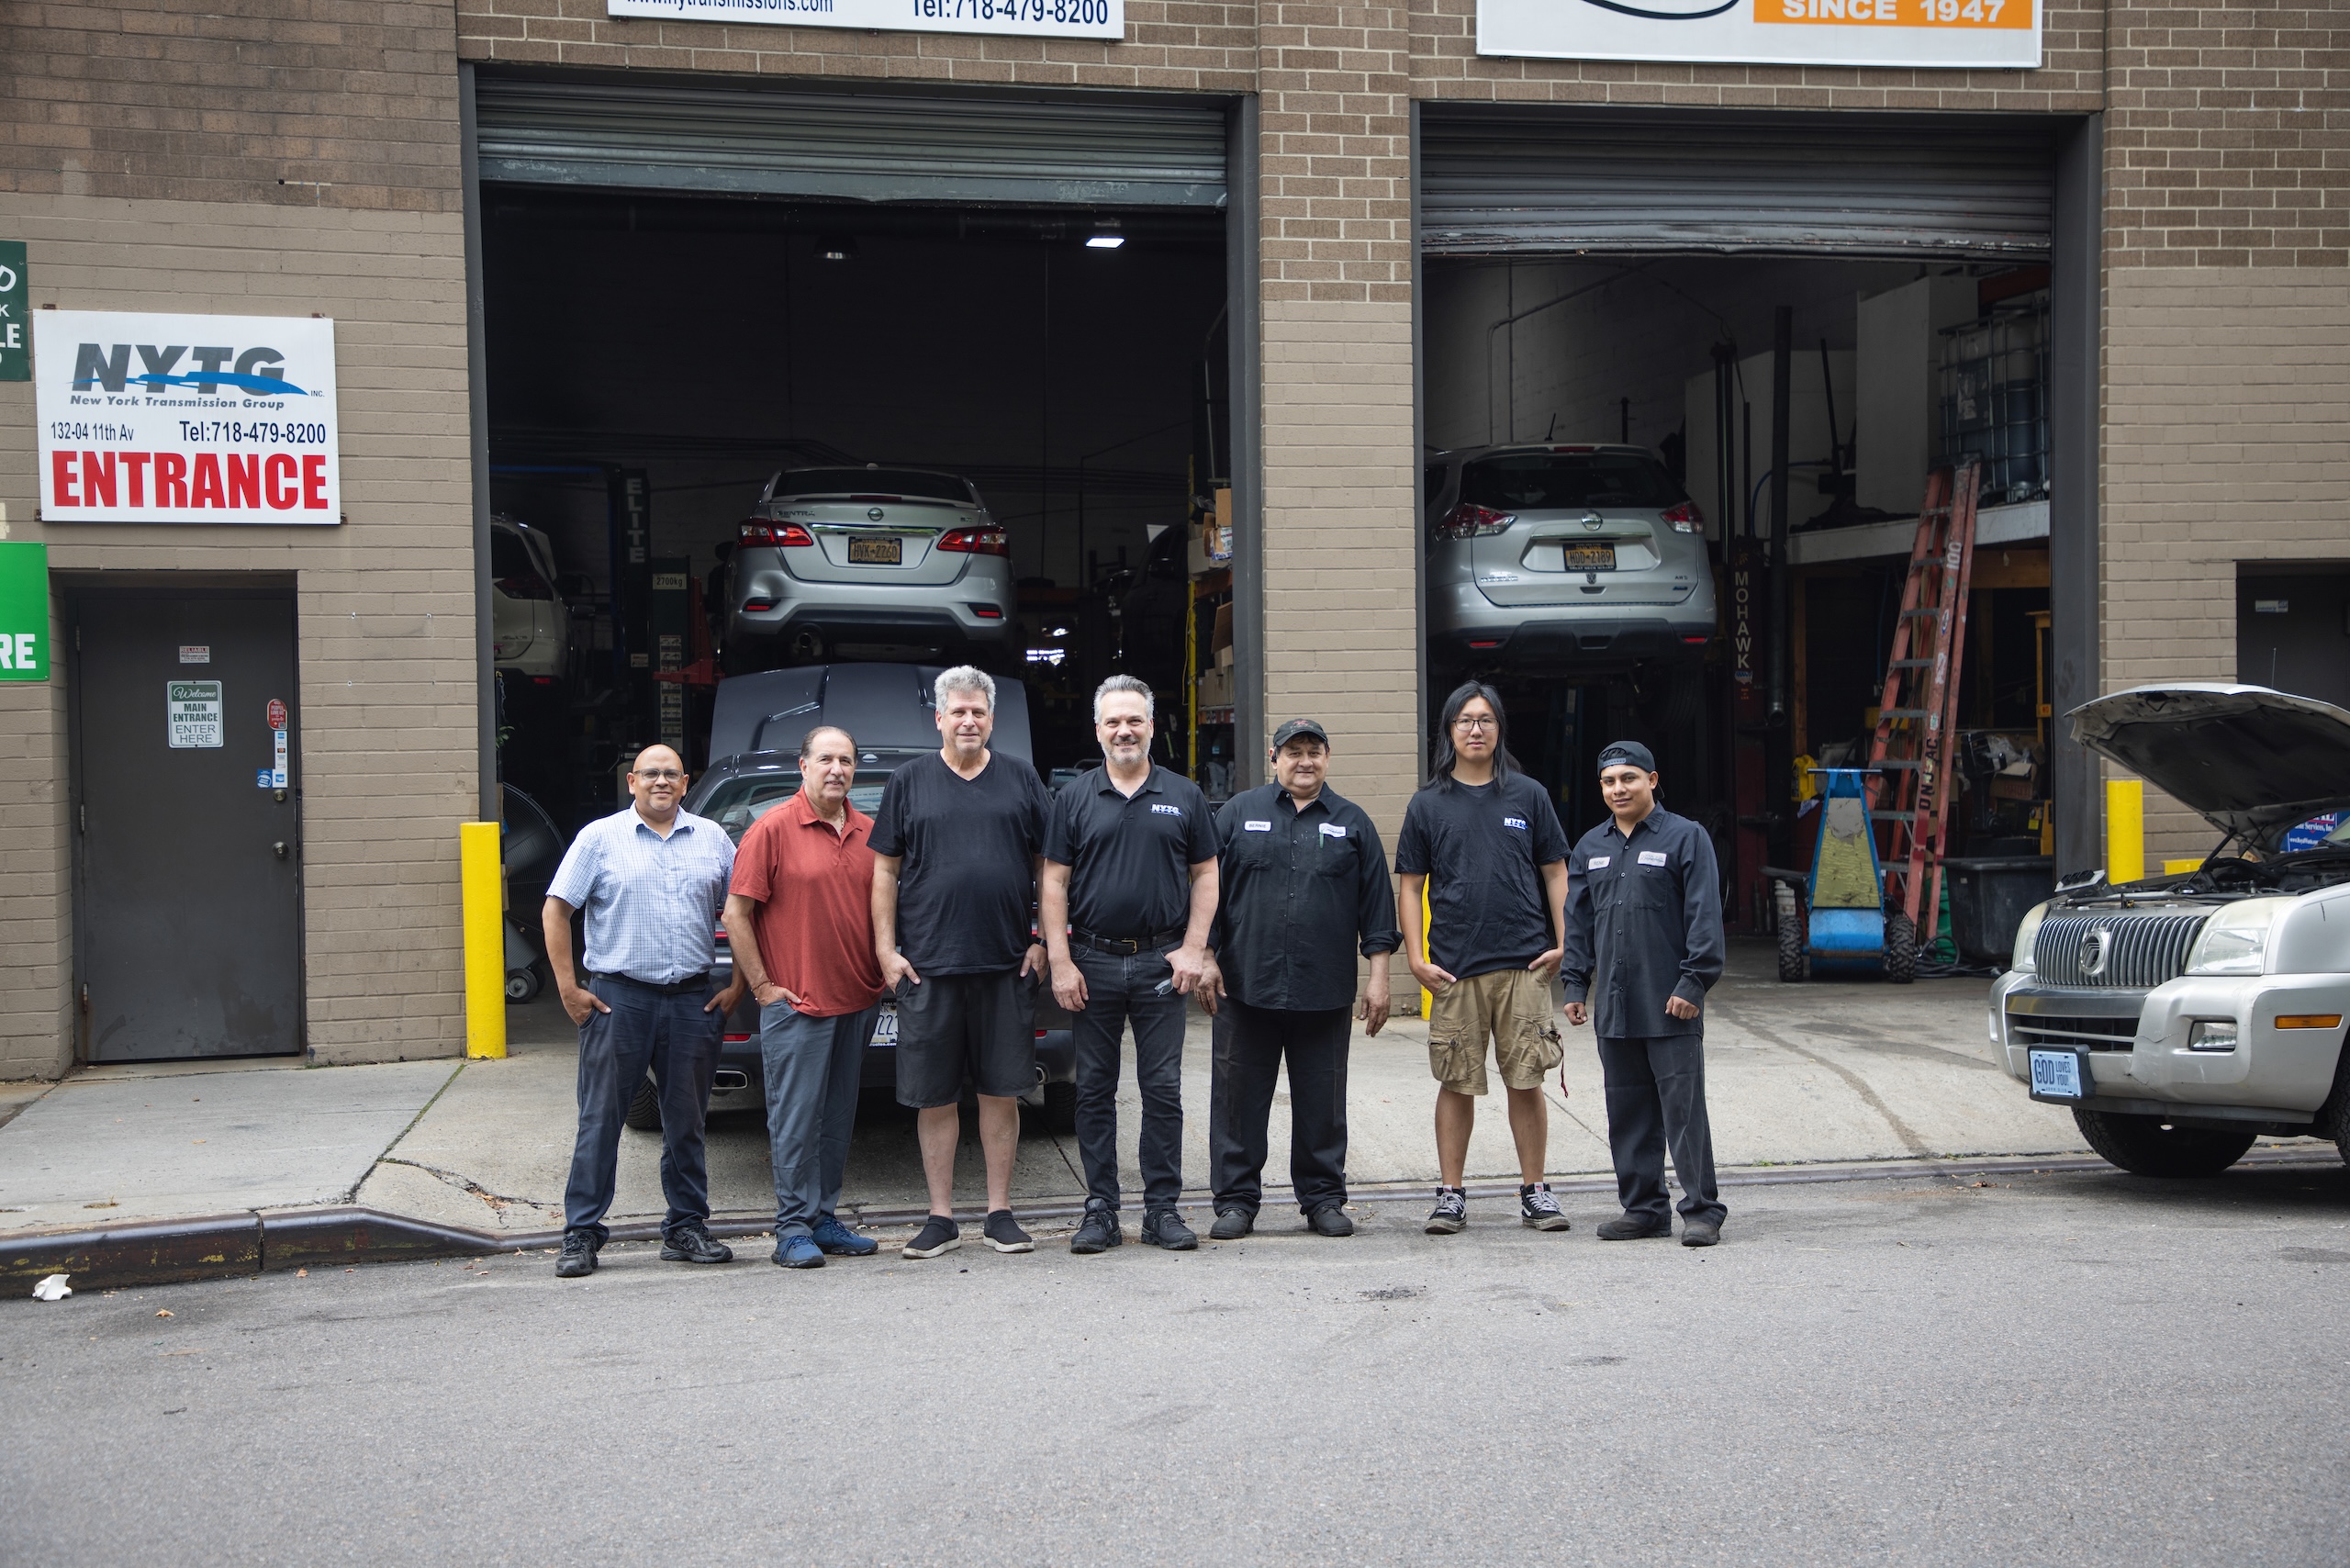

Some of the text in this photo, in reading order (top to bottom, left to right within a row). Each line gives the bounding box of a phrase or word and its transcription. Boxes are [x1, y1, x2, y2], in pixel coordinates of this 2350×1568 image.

[1782, 0, 2006, 23] SINCE 1947
[72, 342, 285, 397] NYTG
[70, 395, 285, 410] New York Transmission Group
[50, 421, 134, 442] 132-04 11th Av
[179, 420, 326, 443] Tel:718-479-8200
[51, 450, 329, 510] ENTRANCE
[626, 477, 645, 564] ELITE
[656, 577, 683, 588] 2700kg
[1734, 570, 1751, 669] MOHAWK
[173, 686, 217, 699] Welcome
[173, 712, 218, 722] ENTRANCE
[184, 703, 207, 712] MAIN
[175, 724, 216, 734] ENTER
[180, 734, 213, 744] HERE
[2034, 1058, 2071, 1085] GOD LOVES
